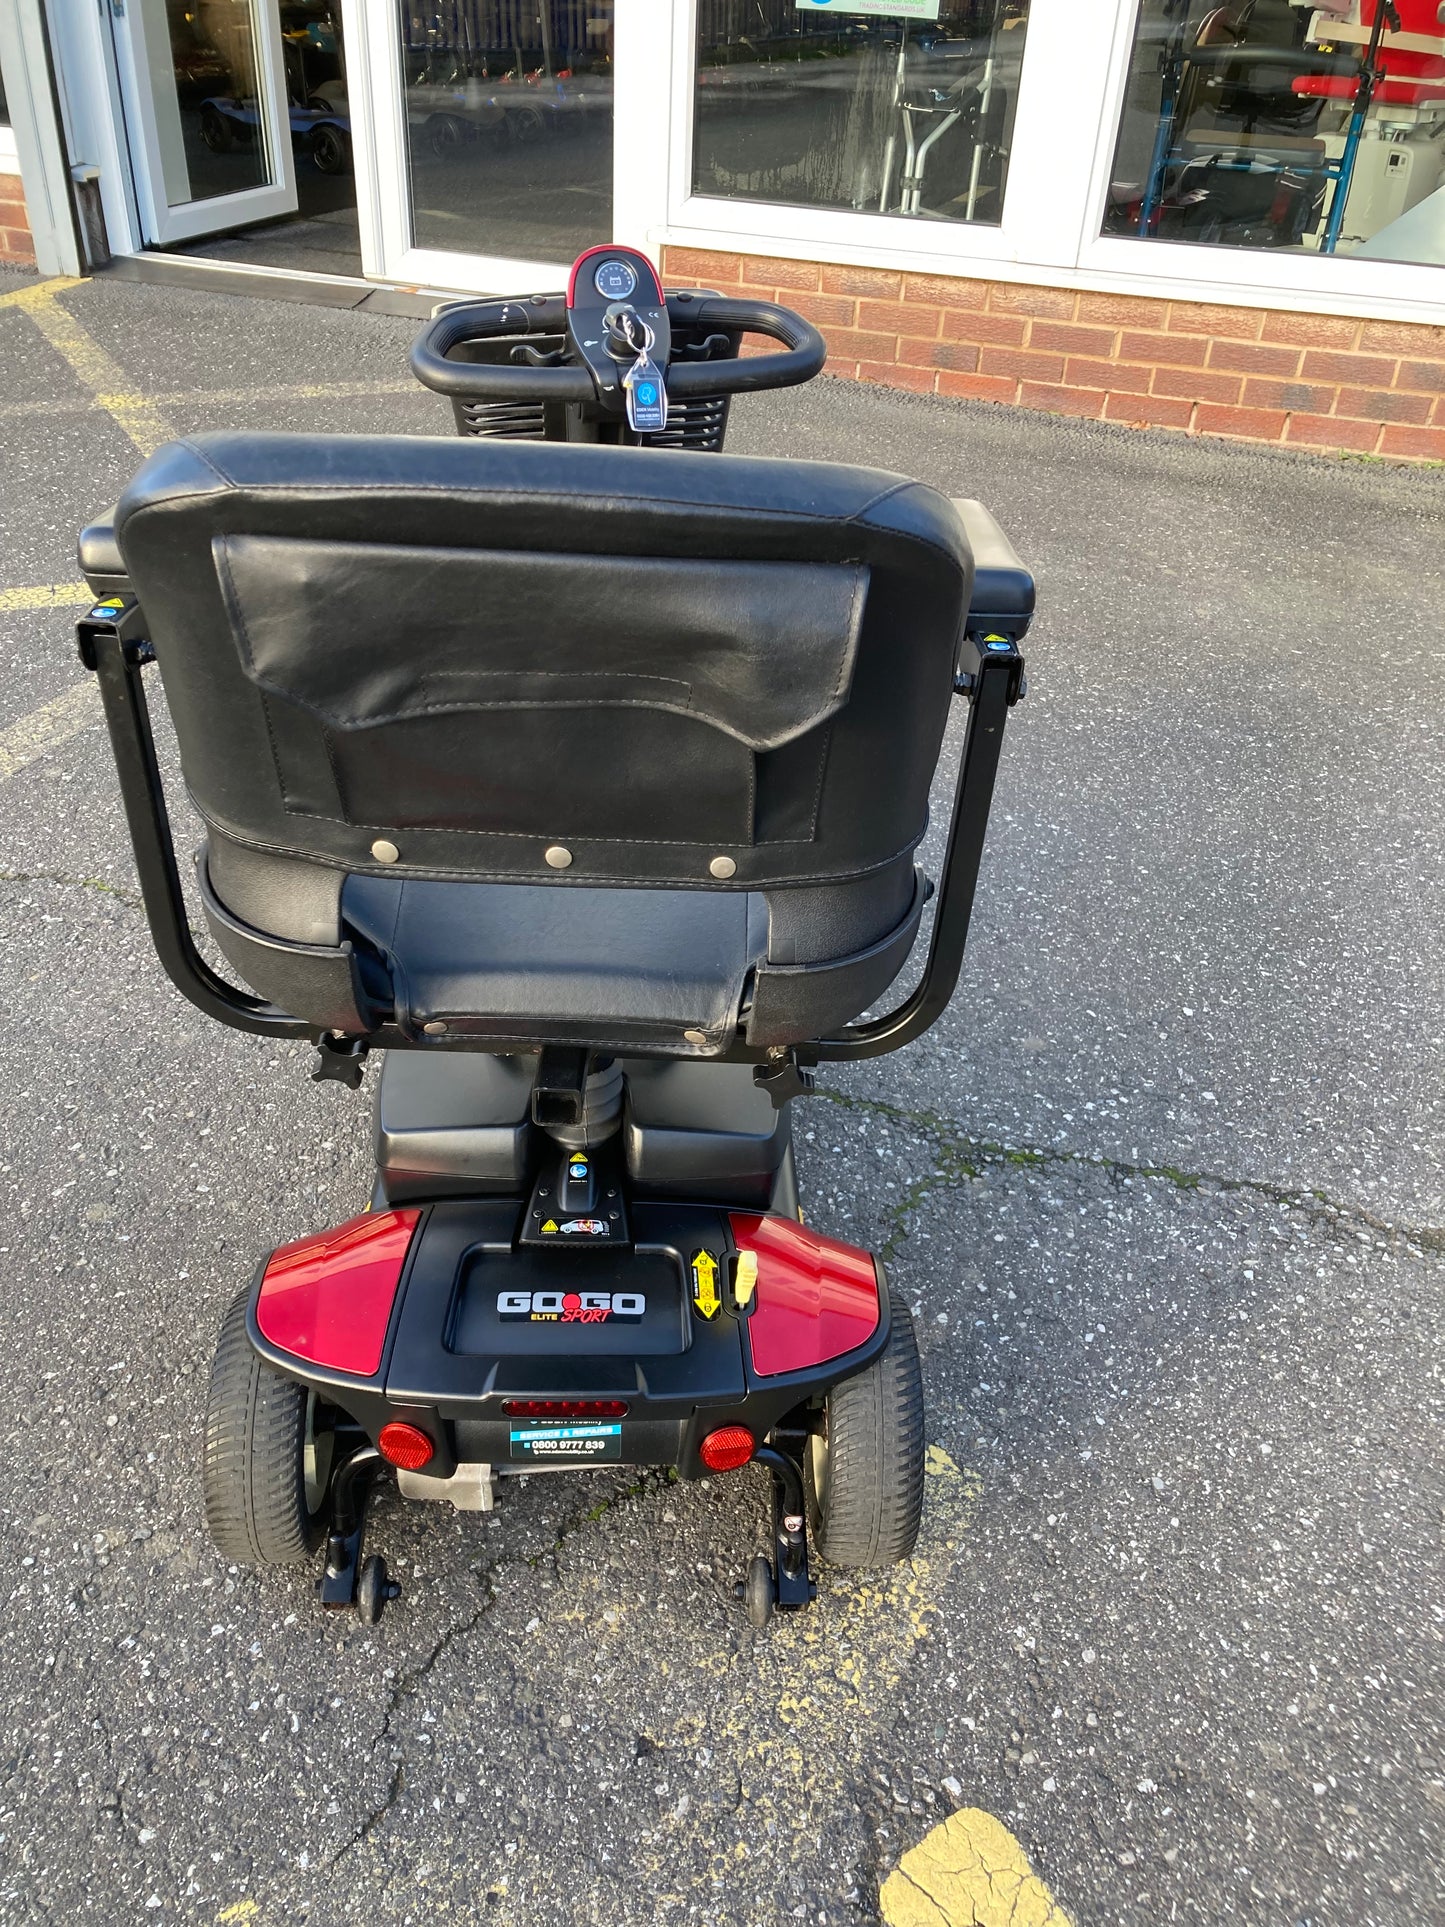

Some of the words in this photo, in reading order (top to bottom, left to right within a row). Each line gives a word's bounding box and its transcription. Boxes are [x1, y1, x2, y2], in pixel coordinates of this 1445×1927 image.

[561, 1309, 612, 1323] SPORT
[520, 1430, 560, 1440] SERVICE
[562, 1430, 570, 1438] &
[572, 1427, 613, 1436] REPAIRS
[531, 1441, 557, 1449] 0800
[559, 1441, 584, 1449] 9777
[585, 1441, 605, 1449] 839
